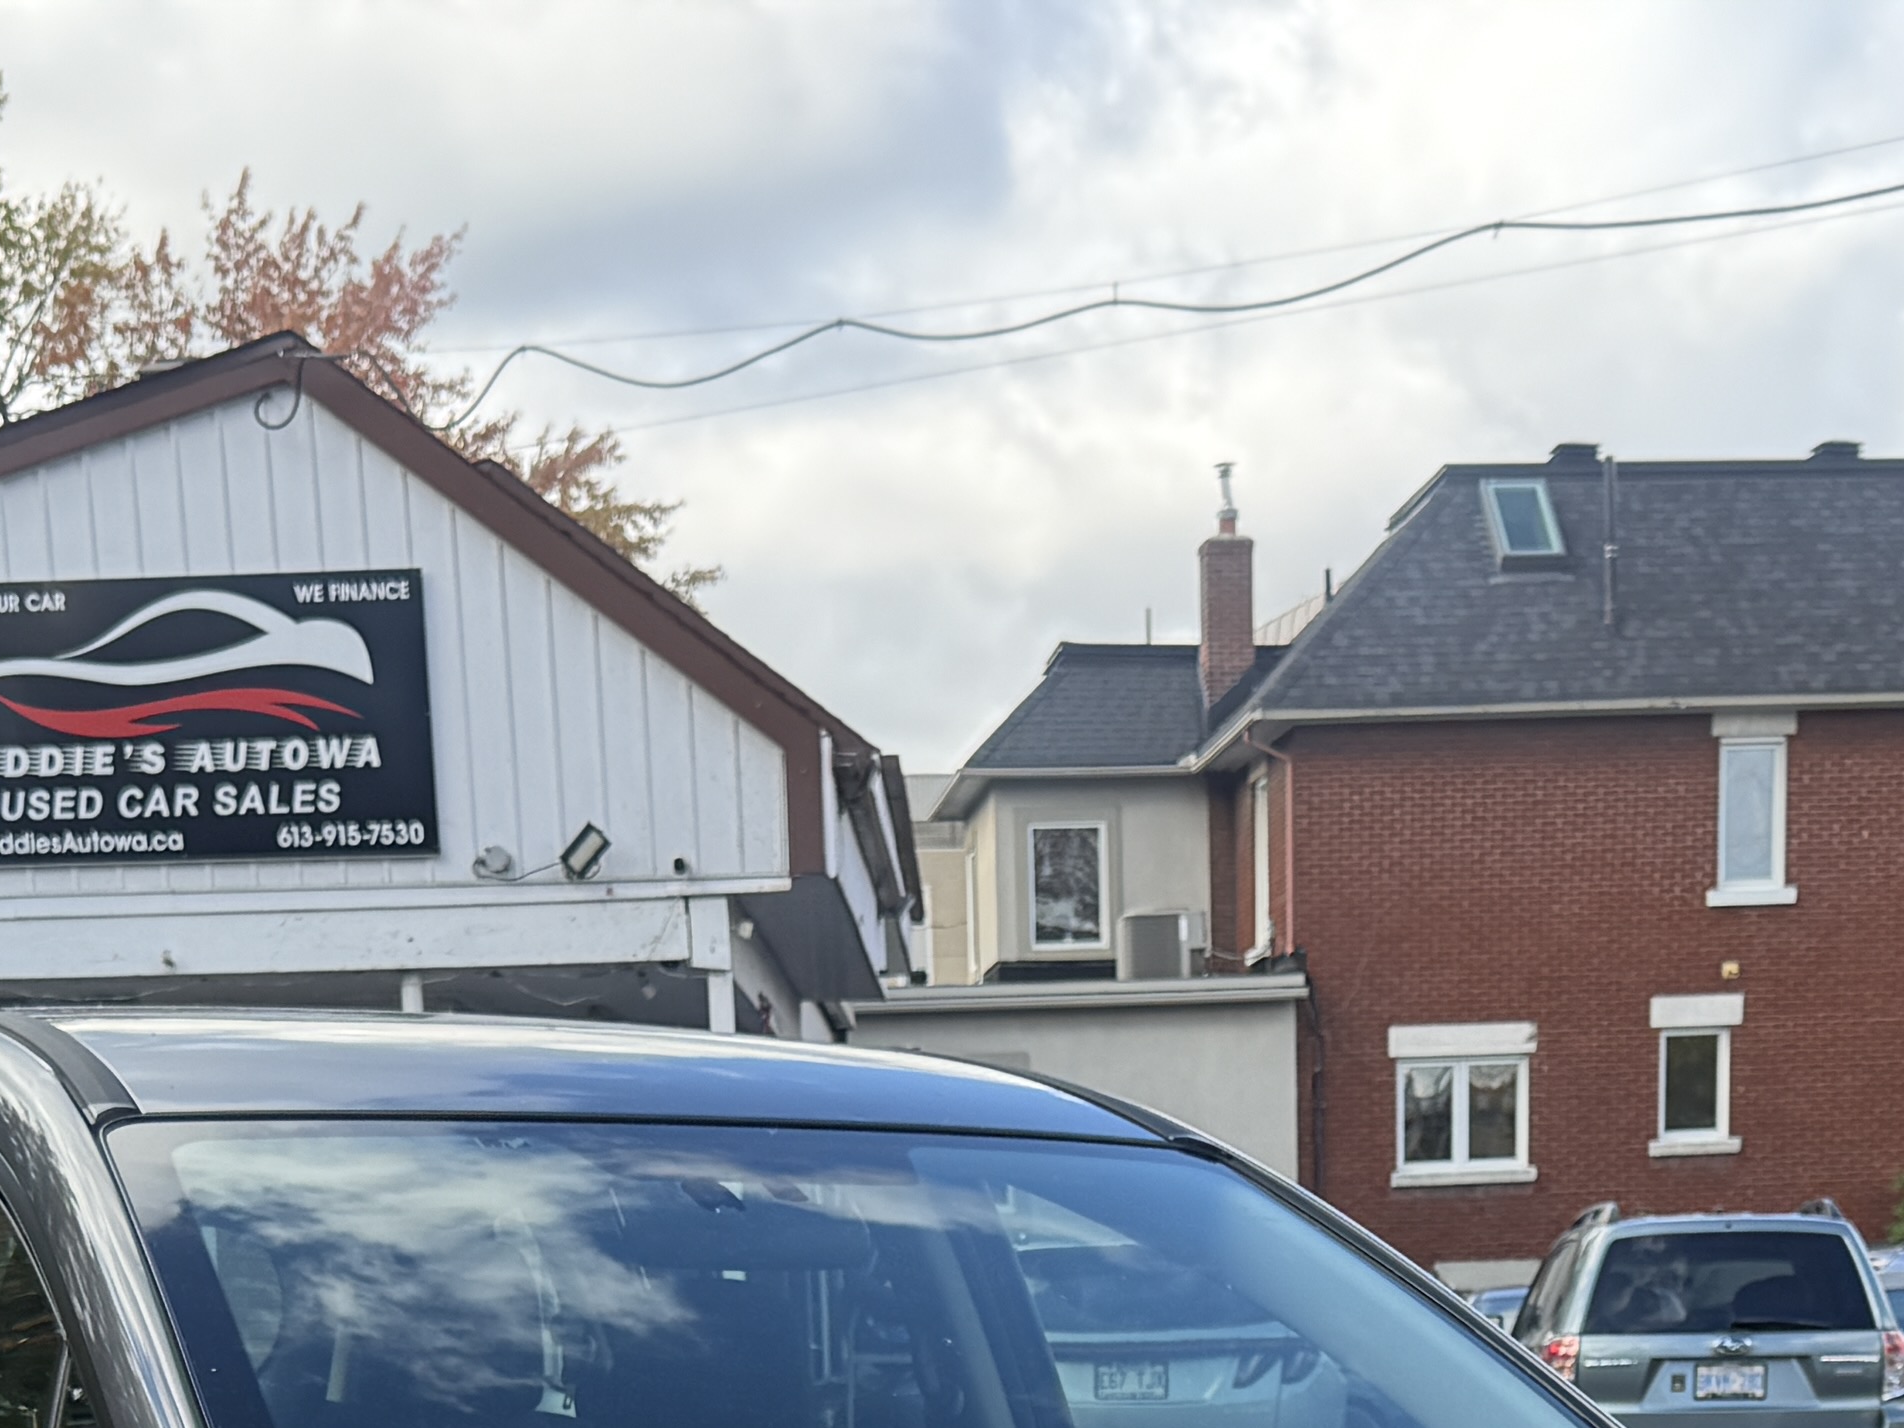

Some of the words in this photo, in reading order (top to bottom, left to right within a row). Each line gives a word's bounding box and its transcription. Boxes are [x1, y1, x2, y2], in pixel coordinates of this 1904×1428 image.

[24, 592, 66, 613] CAR
[293, 582, 325, 603] WE
[327, 580, 411, 602] FINANCE
[179, 736, 383, 775] AUTOWA
[0, 788, 103, 823] USED
[117, 784, 200, 819] CAR
[213, 779, 342, 817] SALES
[276, 819, 426, 850] 613-915-7530
